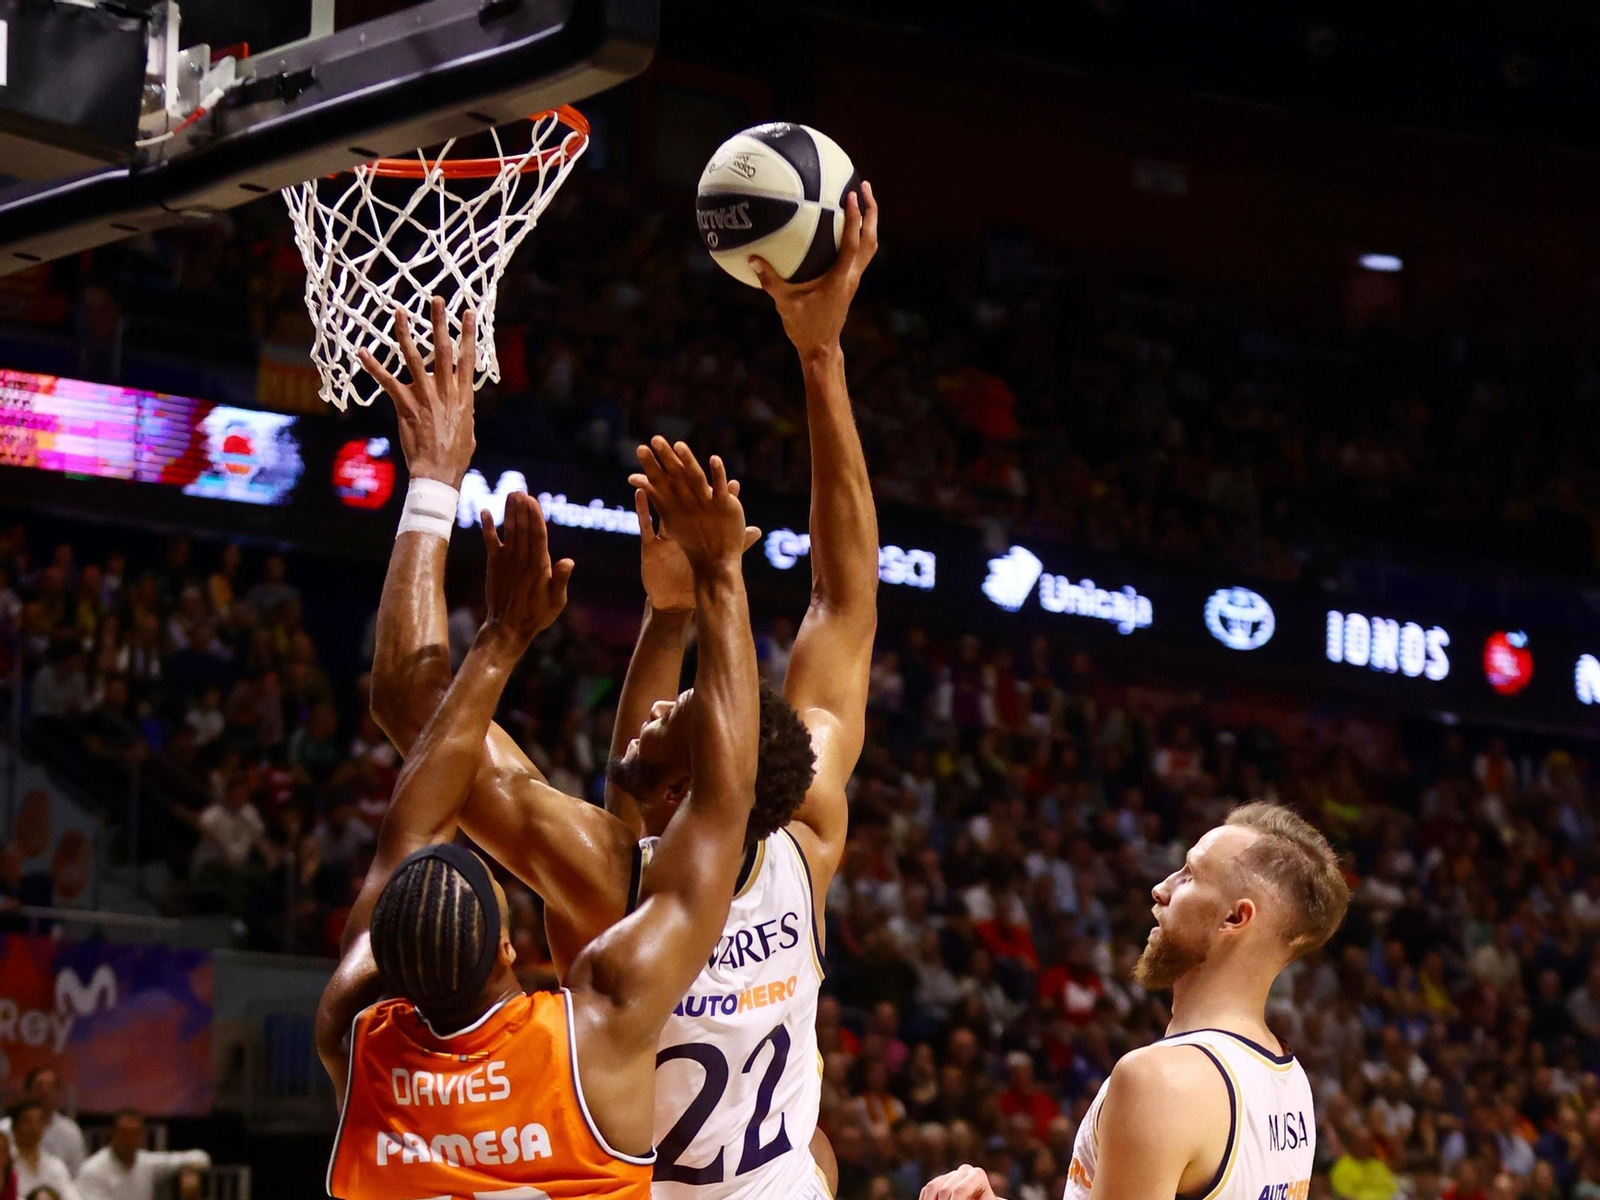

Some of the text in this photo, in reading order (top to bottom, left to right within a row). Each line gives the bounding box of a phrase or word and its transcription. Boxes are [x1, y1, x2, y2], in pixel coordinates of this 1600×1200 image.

[1039, 572, 1153, 634] Unicaja
[1326, 609, 1450, 681] IONOS
[392, 1060, 511, 1106] DAVIES
[652, 1023, 794, 1186] 22
[376, 1122, 553, 1167] PAMESA
